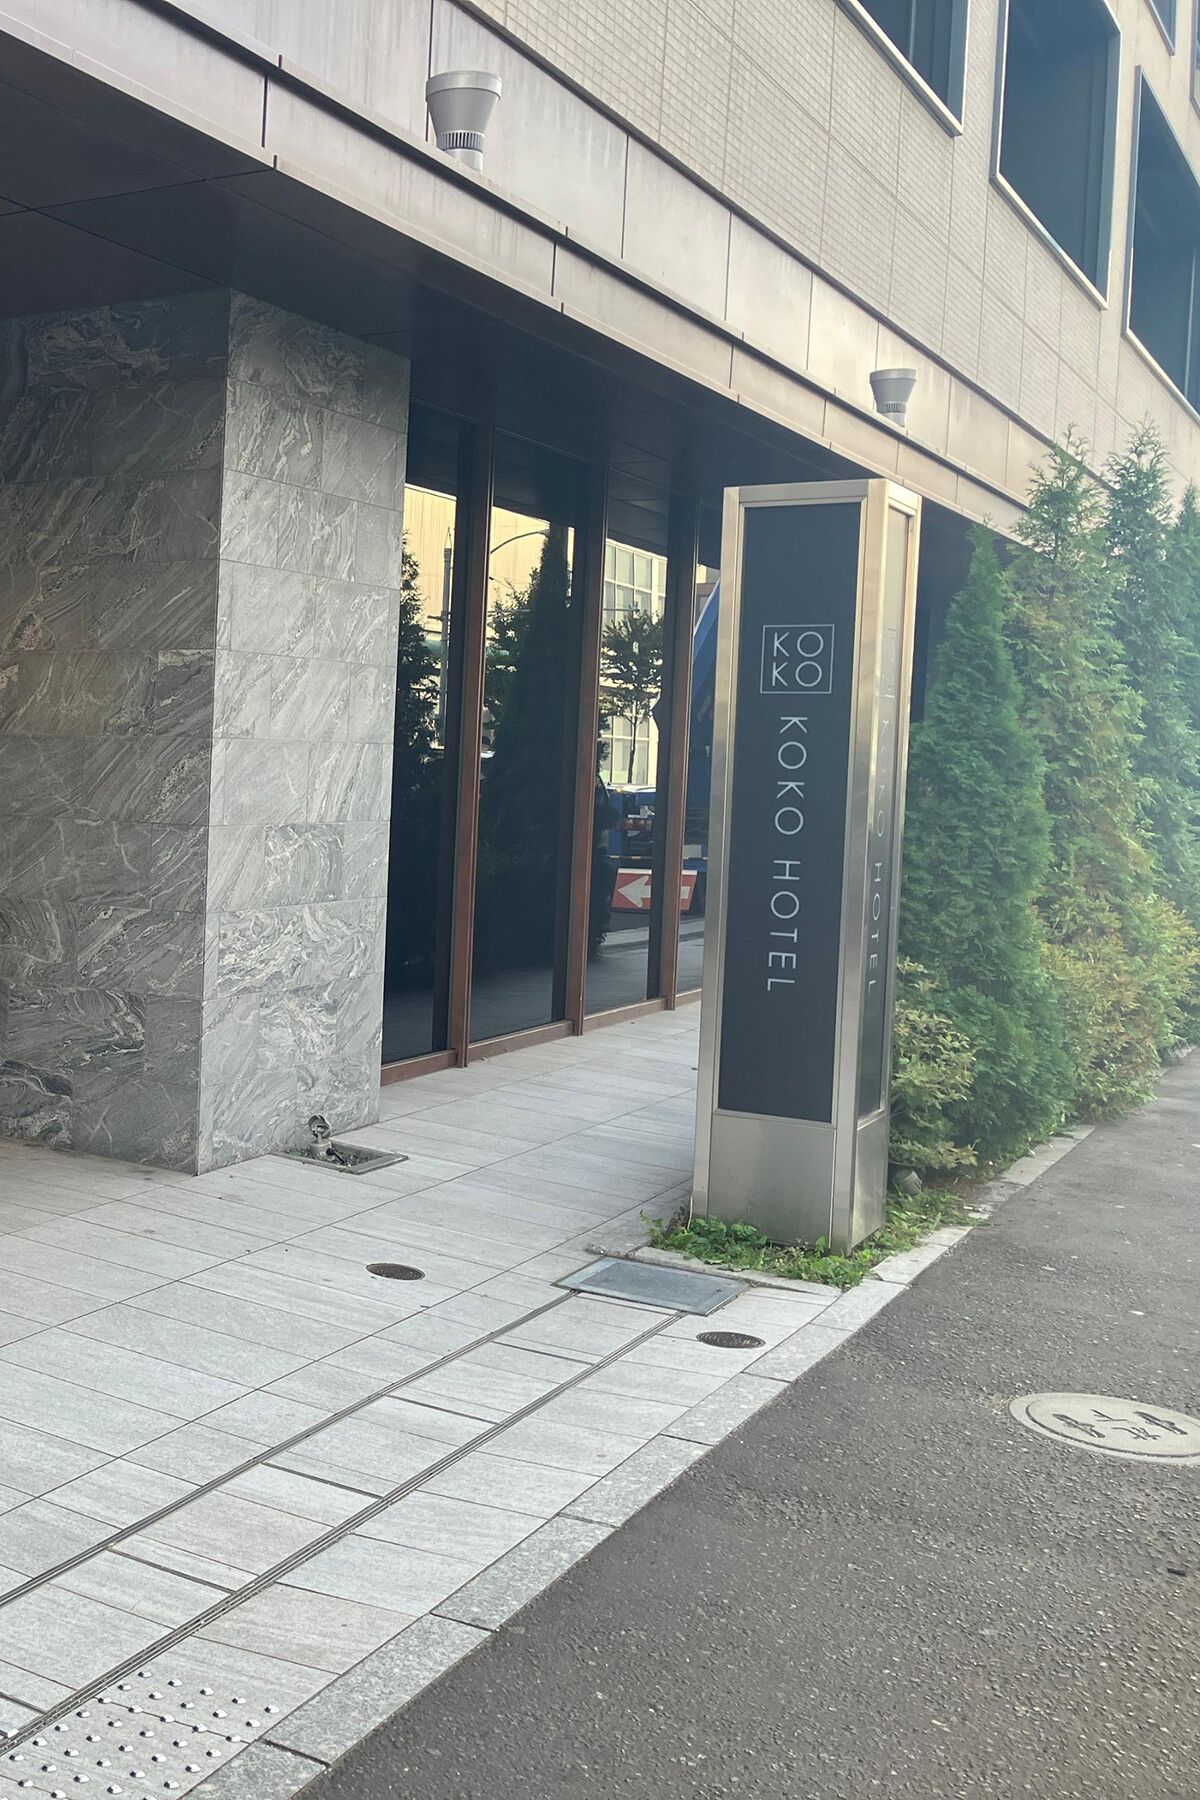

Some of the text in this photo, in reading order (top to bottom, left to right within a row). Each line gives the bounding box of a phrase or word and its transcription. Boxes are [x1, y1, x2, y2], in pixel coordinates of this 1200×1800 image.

[771, 660, 823, 688] KO
[774, 631, 824, 658] KO
[766, 716, 809, 992] KOKO HOTEL
[869, 862, 883, 994] HOTEL
